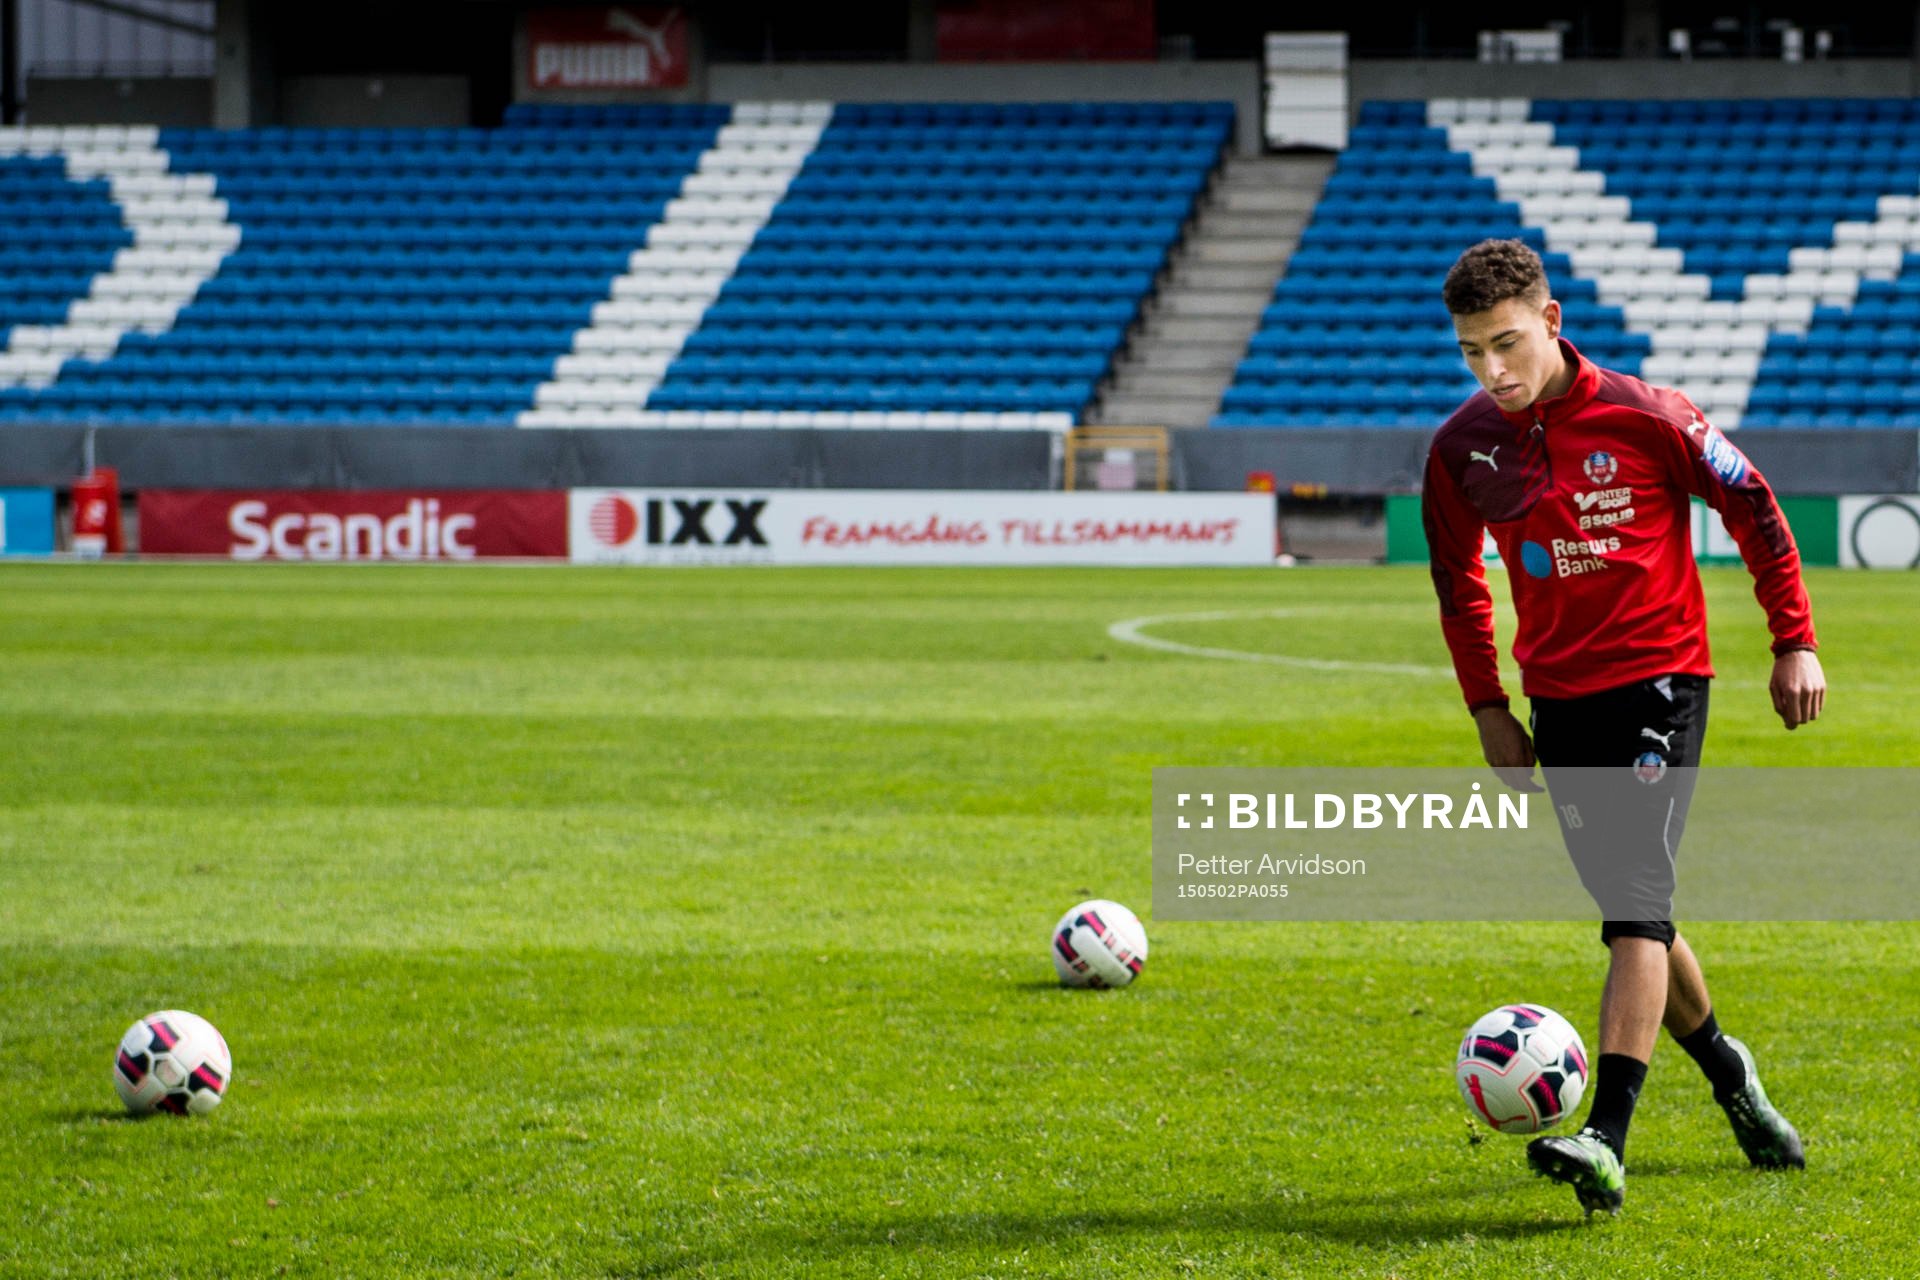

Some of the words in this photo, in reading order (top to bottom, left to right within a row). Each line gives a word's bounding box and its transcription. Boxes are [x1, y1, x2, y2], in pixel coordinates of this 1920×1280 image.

[229, 500, 477, 560] Scandic
[647, 499, 769, 546] IXX
[802, 514, 989, 547] FRAMGÅNG
[1000, 517, 1240, 546] TILLSAMMANS
[1551, 536, 1621, 558] Resurs
[1556, 556, 1608, 578] Bank
[1560, 804, 1583, 829] 18
